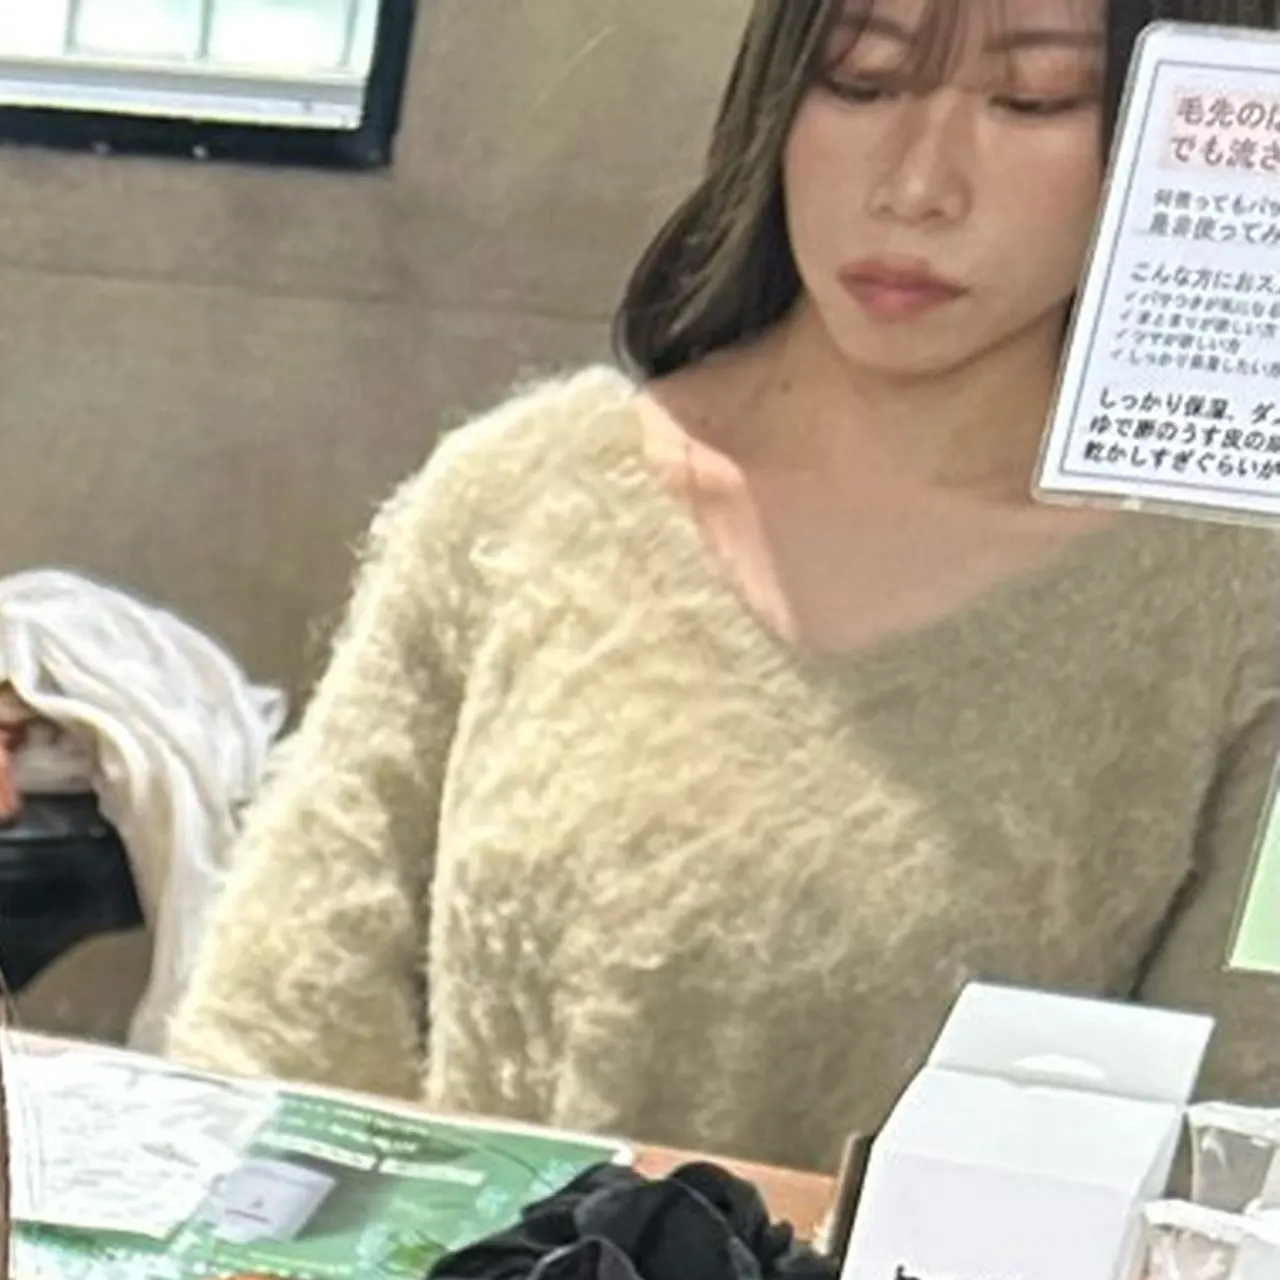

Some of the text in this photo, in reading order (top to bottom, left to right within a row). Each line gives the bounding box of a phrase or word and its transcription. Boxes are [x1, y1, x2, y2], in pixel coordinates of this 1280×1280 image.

[1131, 261, 1280, 294] こんな方におス
